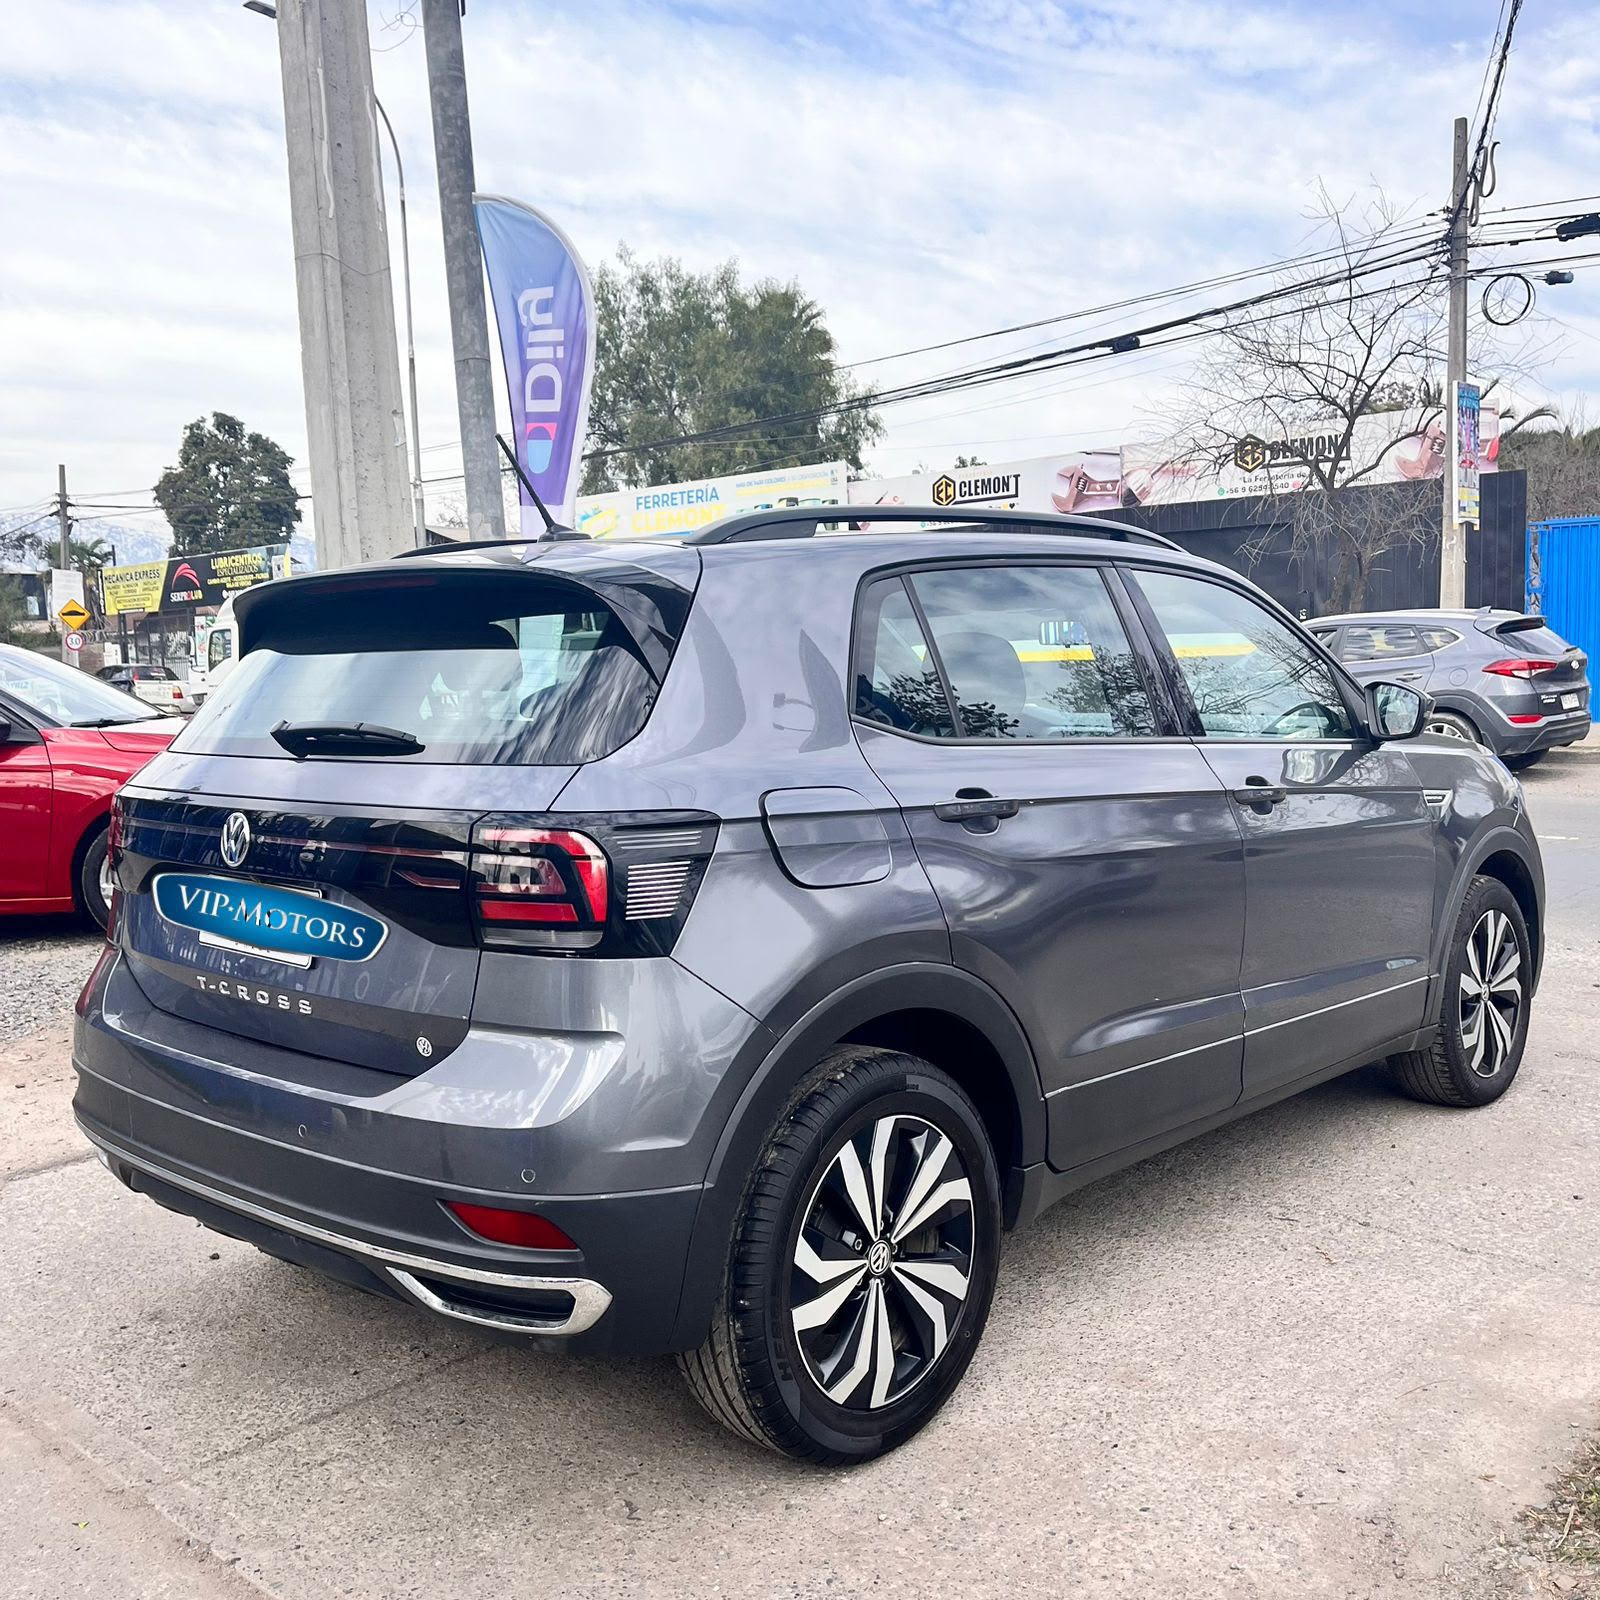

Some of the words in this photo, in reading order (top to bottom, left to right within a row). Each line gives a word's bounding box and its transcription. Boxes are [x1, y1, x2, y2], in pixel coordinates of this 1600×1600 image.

[635, 484, 720, 511] FERRETERÍA
[211, 553, 262, 570] LUBRICENTROS
[133, 569, 160, 580] EXPRESS
[197, 975, 313, 1015] T-CROSS
